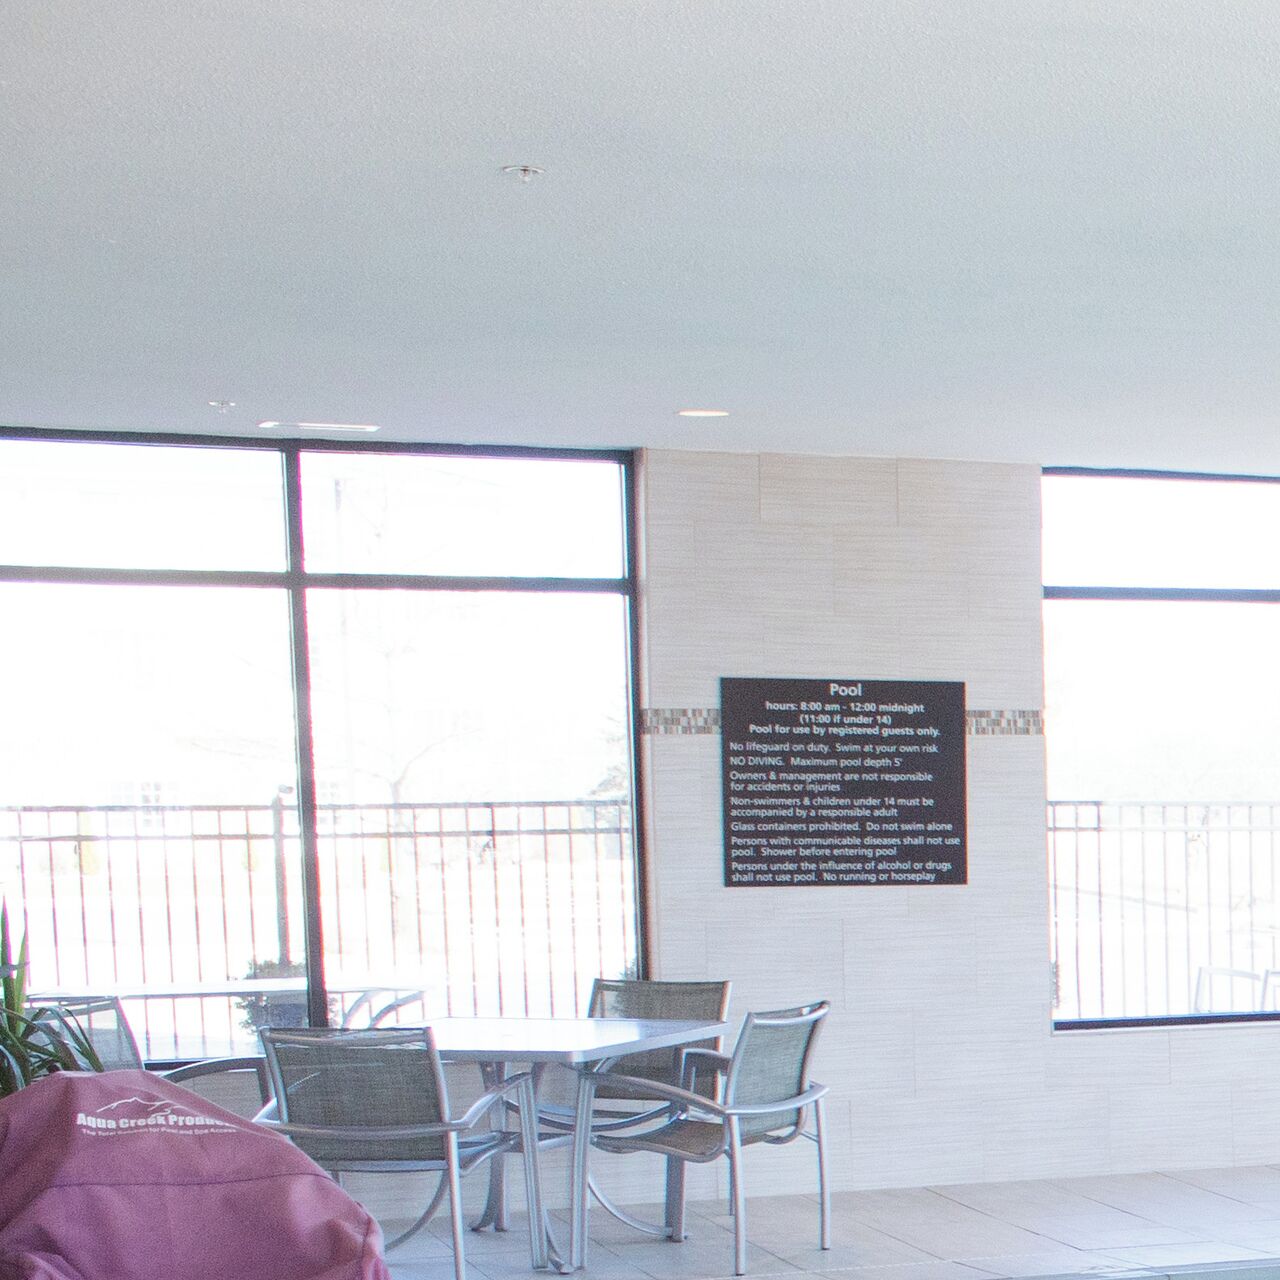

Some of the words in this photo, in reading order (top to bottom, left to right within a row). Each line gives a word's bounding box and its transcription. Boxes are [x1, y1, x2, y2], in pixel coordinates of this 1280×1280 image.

[829, 683, 862, 696] Pool
[800, 702, 822, 711] 8:00
[849, 702, 877, 712] 12:00
[878, 703, 924, 714] midnight
[799, 714, 831, 724] (11:00
[832, 714, 841, 723] if
[843, 715, 873, 724] under
[875, 715, 891, 725] 14)
[749, 724, 772, 733] Pool
[774, 725, 790, 733] for
[792, 726, 810, 734] use
[812, 725, 826, 736] by
[827, 725, 879, 737] registered
[881, 727, 914, 737] guests
[729, 742, 744, 751] No
[745, 742, 790, 753] lifeguard
[835, 743, 861, 752] Swim
[862, 744, 873, 752] at
[874, 745, 897, 754] your
[921, 743, 938, 752] risk
[730, 756, 746, 765] NO
[790, 757, 838, 766] Maximum
[839, 757, 862, 768] pool
[863, 757, 892, 768] depth
[730, 771, 767, 780] Owners
[768, 771, 777, 780] &
[778, 772, 842, 782] management
[861, 773, 878, 781] not
[880, 772, 934, 781] responsible
[730, 781, 745, 791] for
[746, 782, 791, 791] accidents
[805, 782, 840, 793] injuries
[730, 796, 801, 805] Non-swimmers
[802, 796, 810, 805] &
[812, 796, 851, 805] children
[852, 797, 881, 806] under
[883, 797, 895, 805] 14
[896, 798, 920, 806] must
[921, 797, 934, 806] be
[730, 807, 794, 816] accompanied
[795, 807, 808, 818] by
[817, 807, 871, 817] responsible
[872, 807, 898, 816] adult
[730, 821, 756, 831] Glass
[865, 821, 880, 830] Do
[881, 822, 899, 831] not
[899, 822, 925, 830] swim
[926, 821, 953, 830] alone
[731, 836, 768, 845] Persons
[768, 836, 791, 845] with
[792, 836, 862, 845] communicable
[863, 836, 901, 845] diseases
[902, 836, 924, 845] shall
[926, 837, 943, 845] not
[944, 837, 961, 845] use
[760, 847, 797, 856] Shower
[798, 847, 831, 856] before
[832, 847, 873, 857] entering
[874, 847, 897, 857] pool
[731, 861, 768, 870] Persons
[769, 861, 798, 870] under
[799, 861, 817, 870] the
[818, 860, 863, 870] influence
[864, 860, 875, 870] of
[876, 860, 911, 870] alcohol
[912, 862, 923, 870] or
[924, 860, 952, 871] drugs
[731, 872, 754, 881] shall
[755, 873, 773, 881] not
[822, 872, 837, 881] No
[838, 873, 877, 882] running
[890, 871, 936, 882] horseplay
[77, 1113, 116, 1129] Aqua
[119, 1114, 166, 1128] Creek
